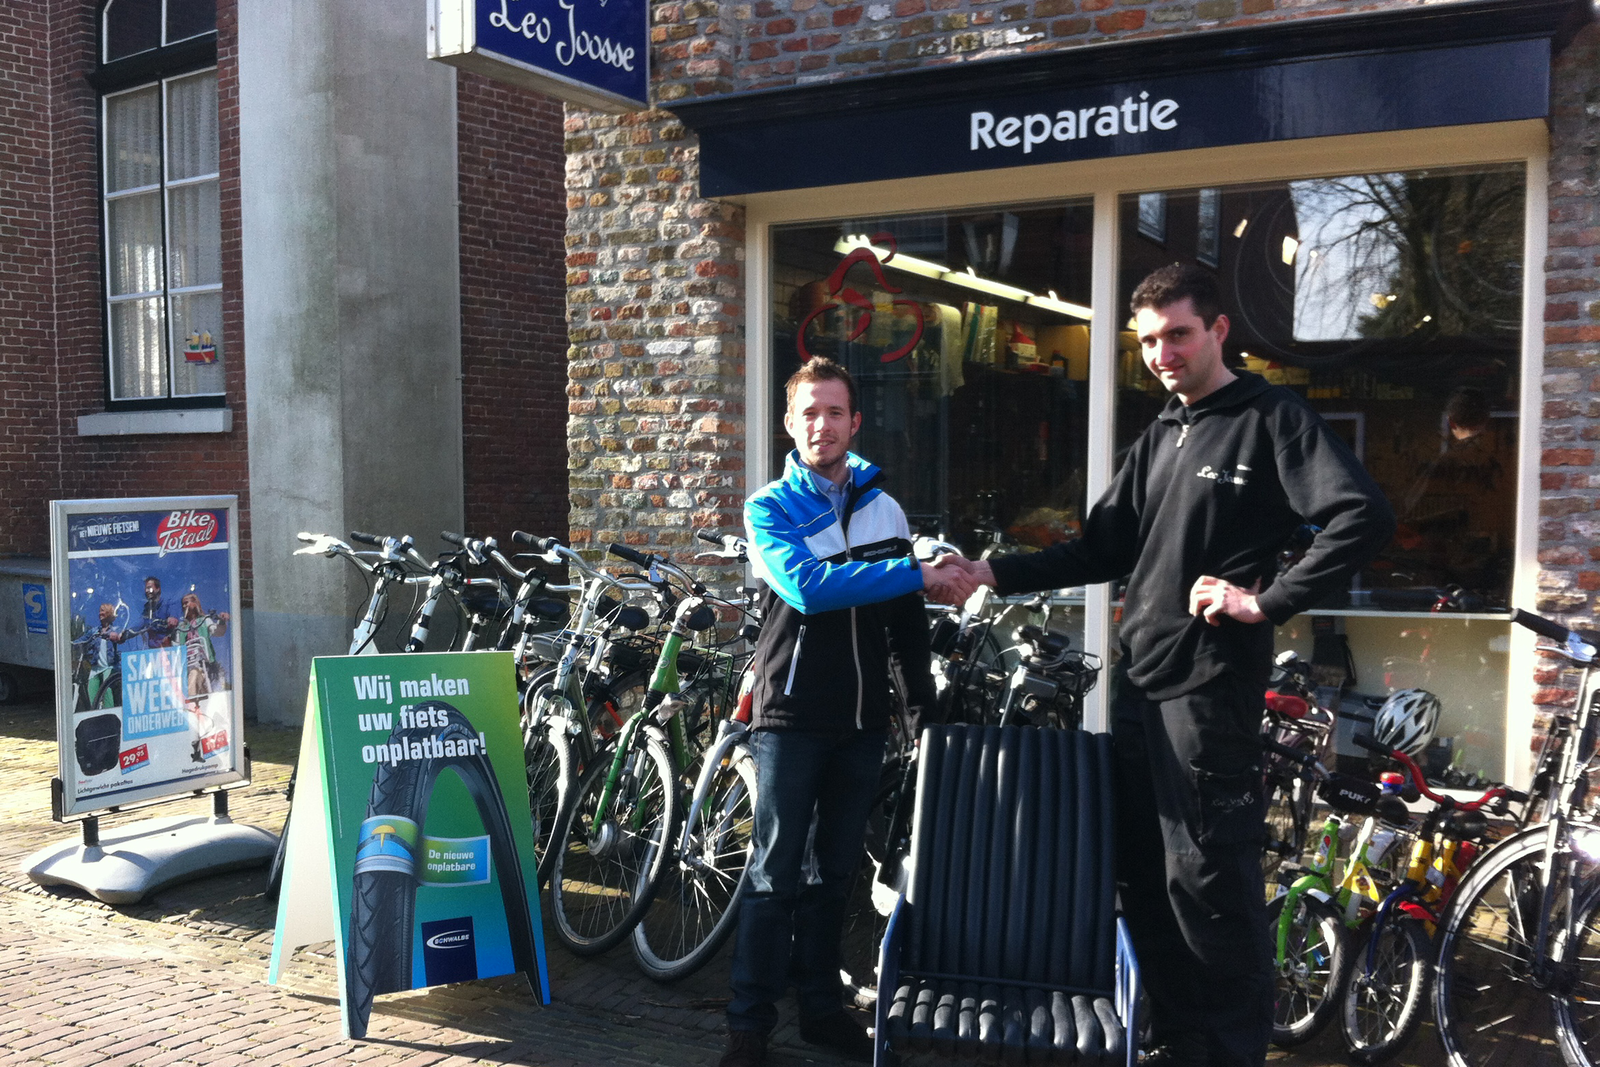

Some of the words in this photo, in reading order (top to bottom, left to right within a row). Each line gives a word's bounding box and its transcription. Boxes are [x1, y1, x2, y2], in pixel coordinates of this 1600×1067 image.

[489, 0, 551, 43] Leo
[556, 0, 635, 72] Joosse
[970, 91, 1180, 154] Reparatie
[87, 523, 112, 537] NIEUWE
[167, 510, 211, 528] Bike
[158, 519, 216, 558] Totaal
[353, 675, 393, 704] Wij
[399, 673, 470, 698] maken
[358, 711, 393, 732] uw
[400, 705, 449, 730] fiets
[362, 731, 487, 767] onplatbaar!
[427, 861, 476, 873] onplatbare
[428, 849, 441, 859] De
[443, 850, 475, 860] nieuwe
[434, 934, 470, 945] SCHWALBE
